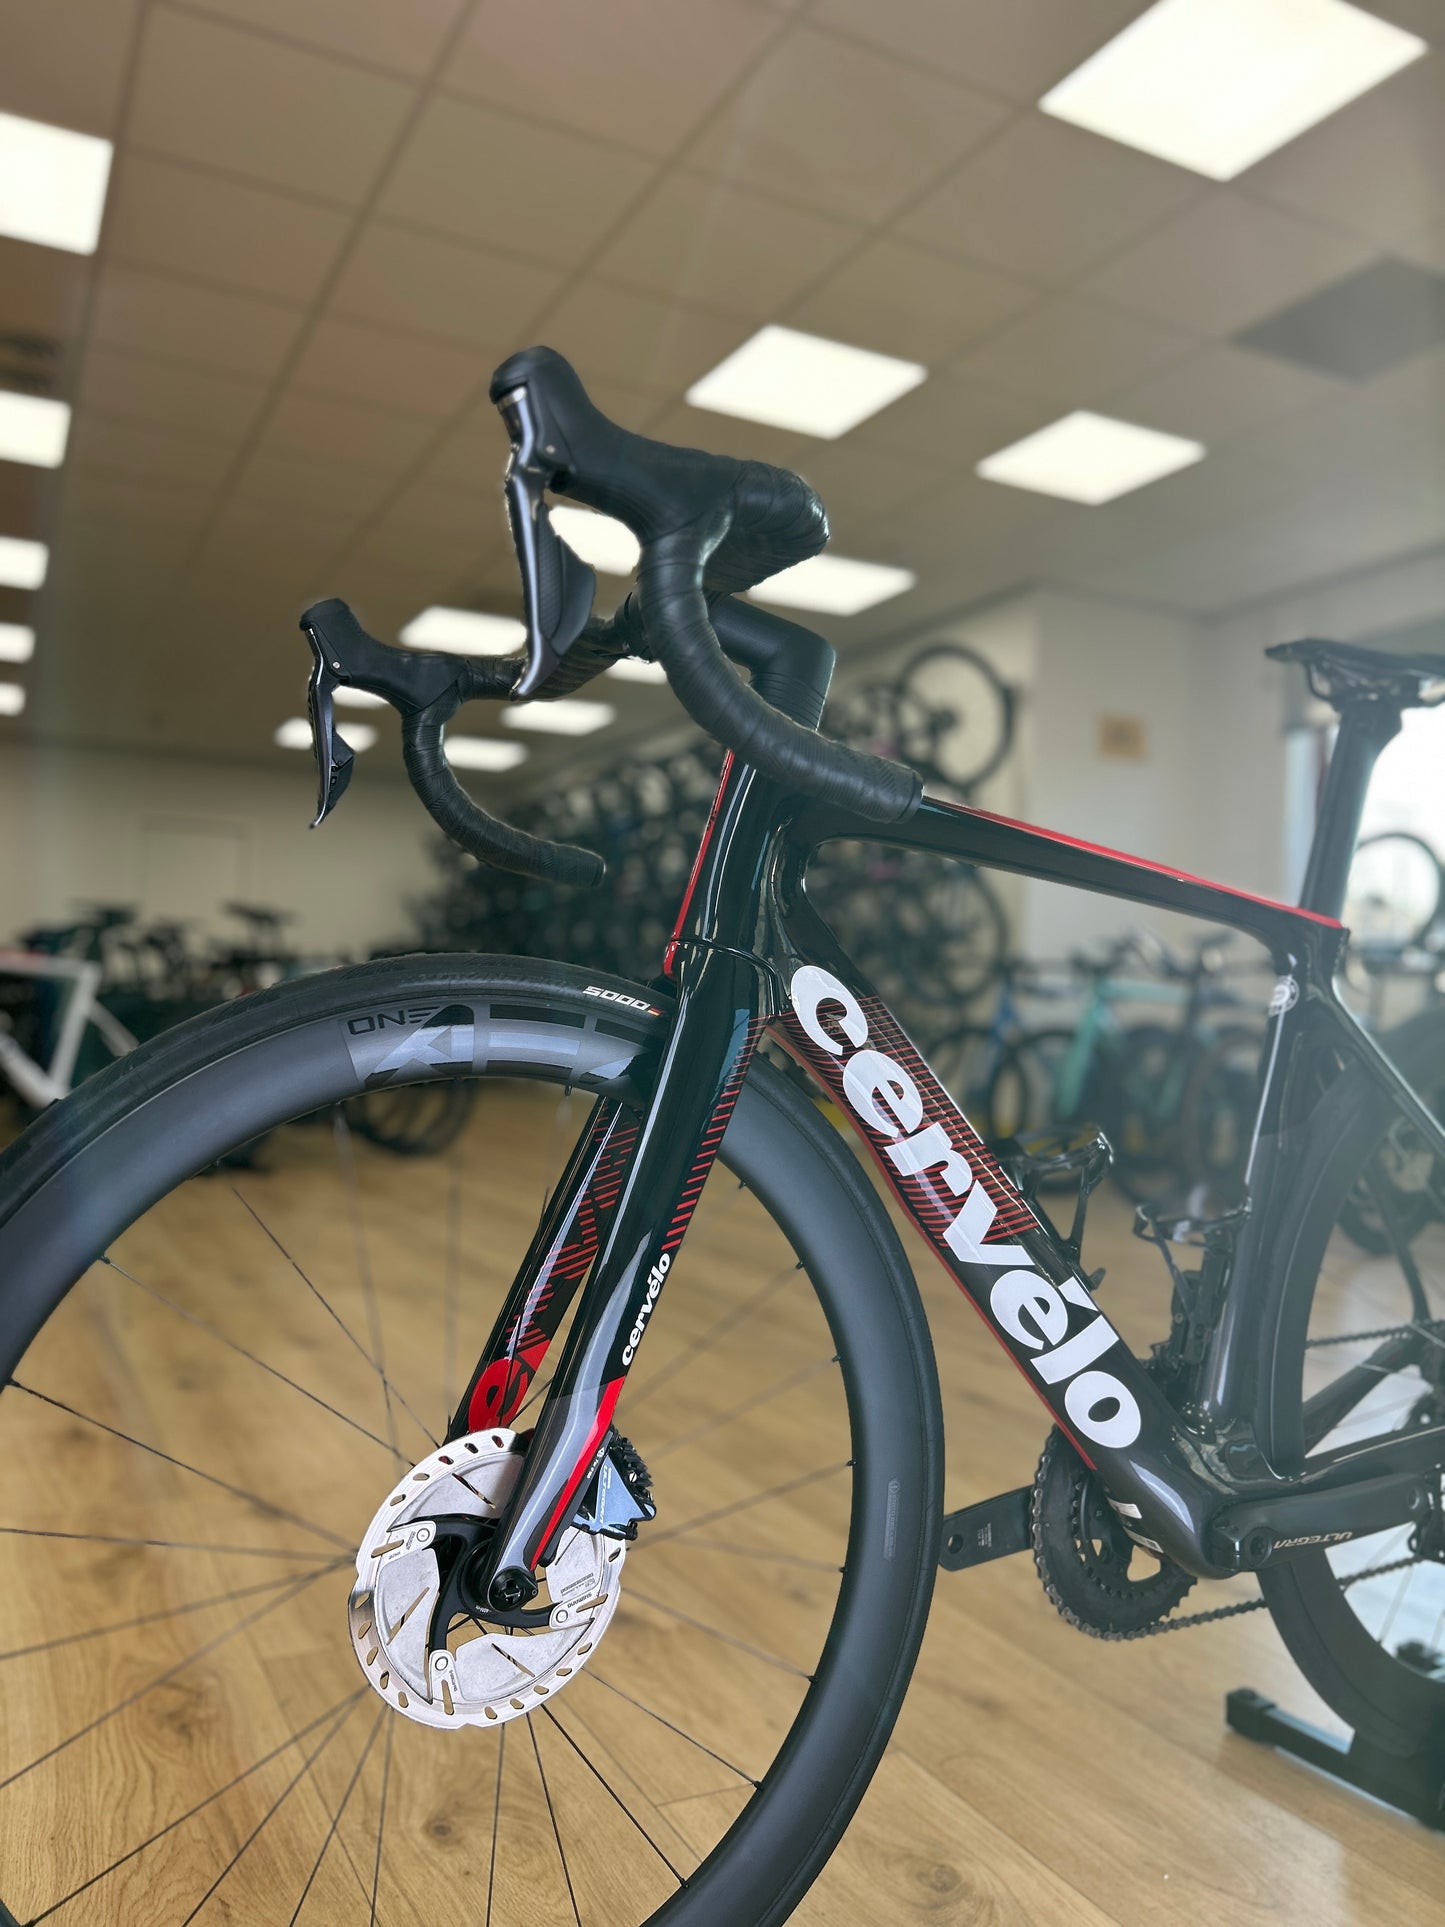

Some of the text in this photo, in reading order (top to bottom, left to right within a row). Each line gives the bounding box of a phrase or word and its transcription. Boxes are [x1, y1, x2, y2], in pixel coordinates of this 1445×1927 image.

[582, 985, 651, 1011] 5000
[347, 1005, 441, 1036] ONE
[790, 965, 1141, 1448] cervélo
[622, 1252, 671, 1366] cervélo
[1273, 1531, 1353, 1550] ULTEGRA
